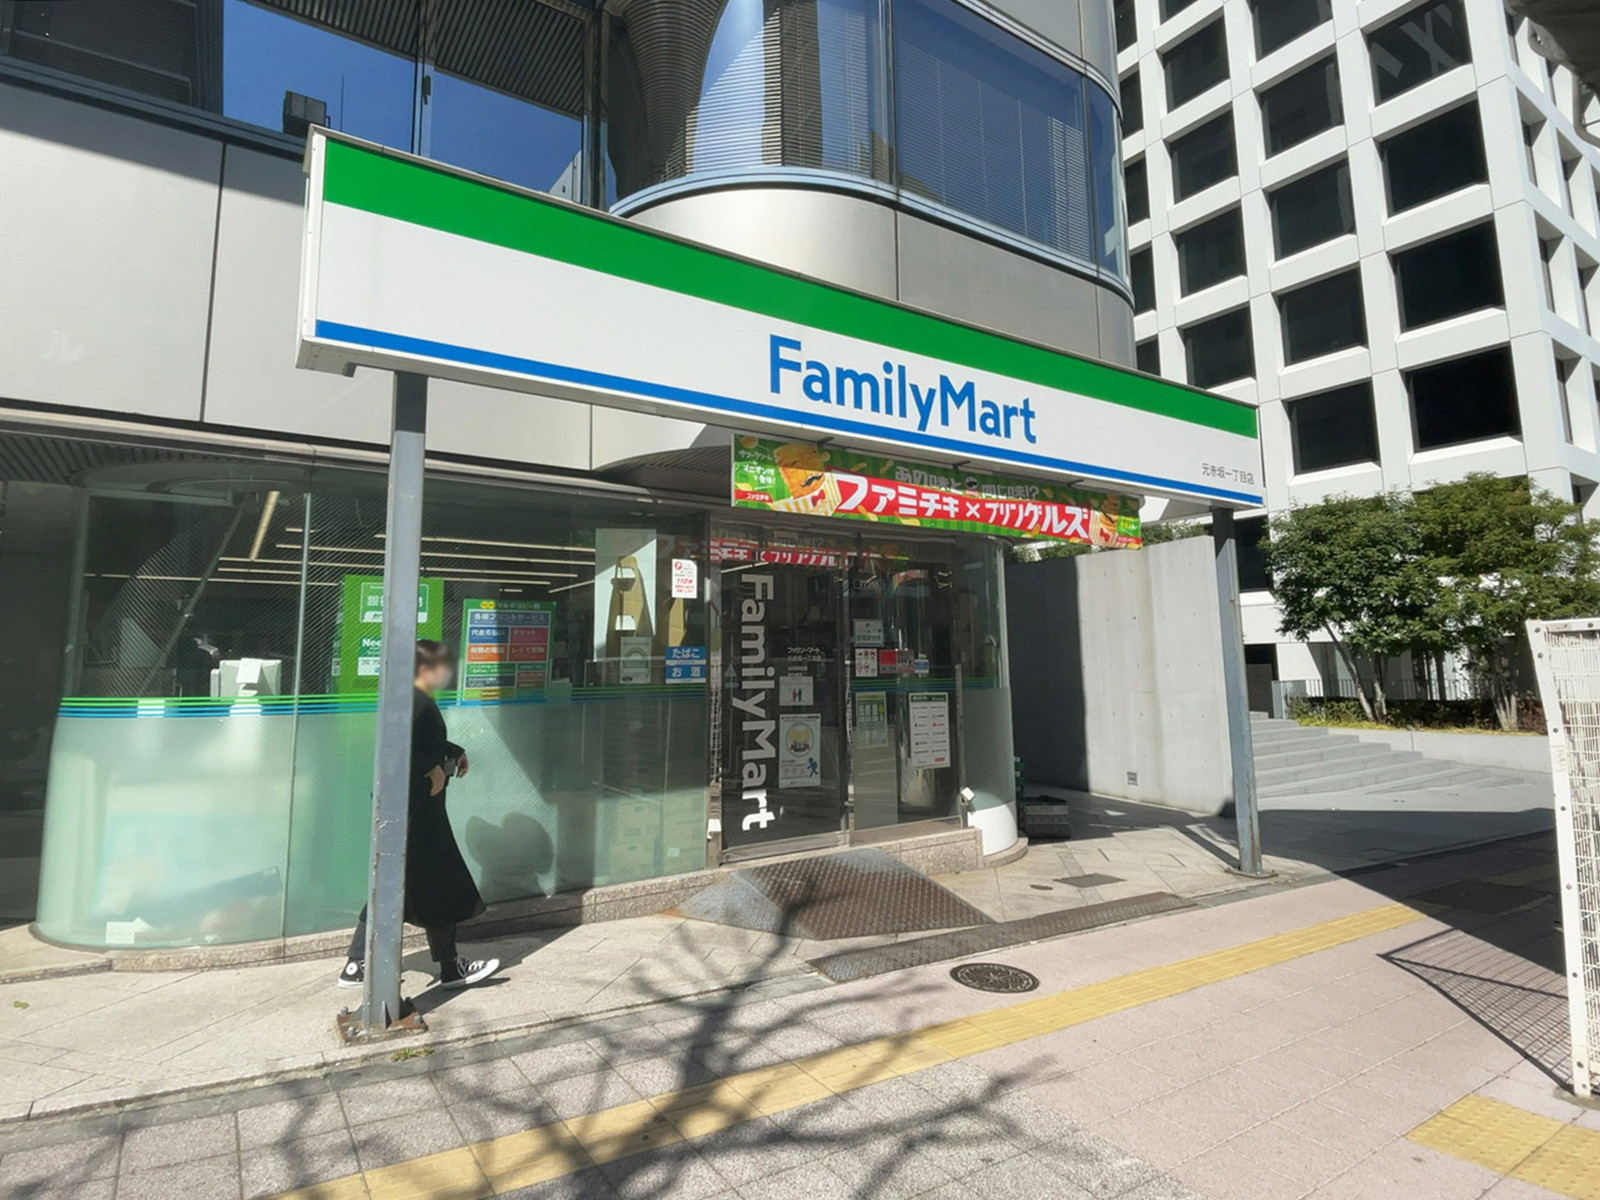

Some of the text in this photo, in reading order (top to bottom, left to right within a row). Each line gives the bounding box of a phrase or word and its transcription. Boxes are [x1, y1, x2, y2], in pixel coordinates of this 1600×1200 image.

[769, 334, 1037, 444] FamilyMart
[672, 647, 701, 659] たばこ
[732, 574, 776, 831] FamilyMart
